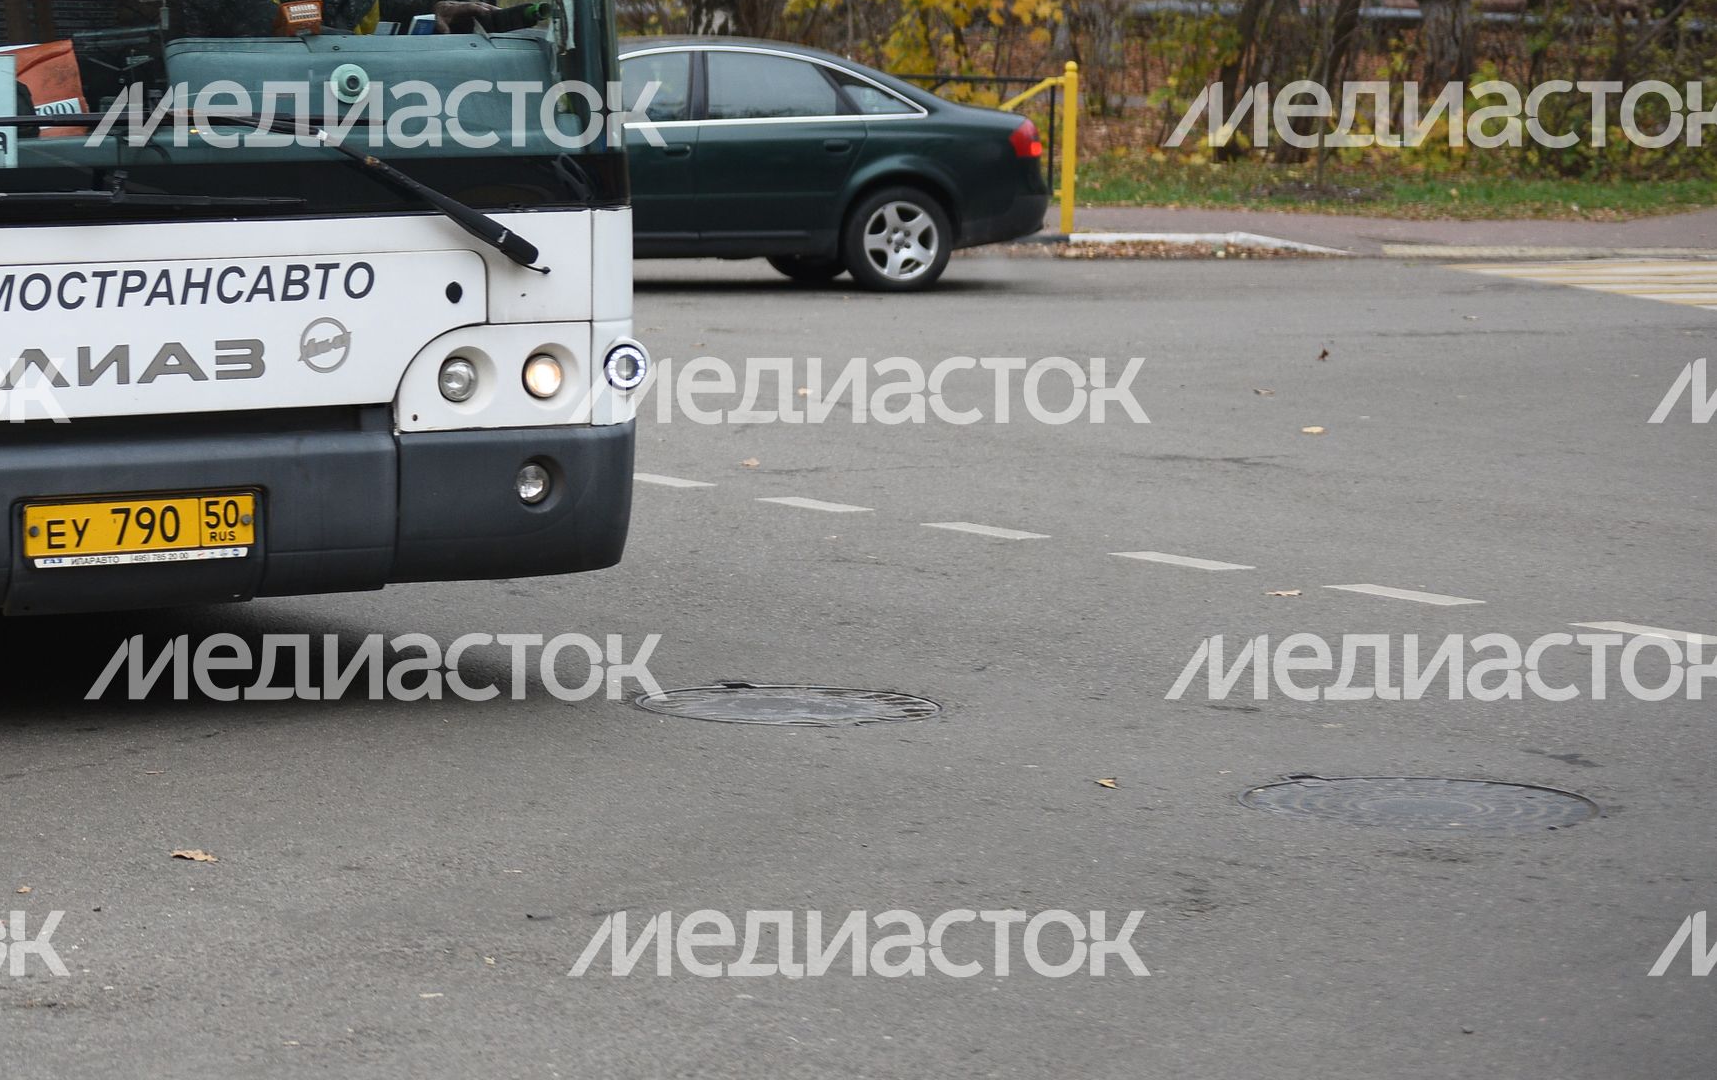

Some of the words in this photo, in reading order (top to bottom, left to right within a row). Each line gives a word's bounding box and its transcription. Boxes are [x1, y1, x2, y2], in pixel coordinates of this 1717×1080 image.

[46, 518, 91, 550] ЕУ
[110, 505, 181, 546] 790
[204, 499, 240, 529] 50
[209, 530, 237, 542] RUS
